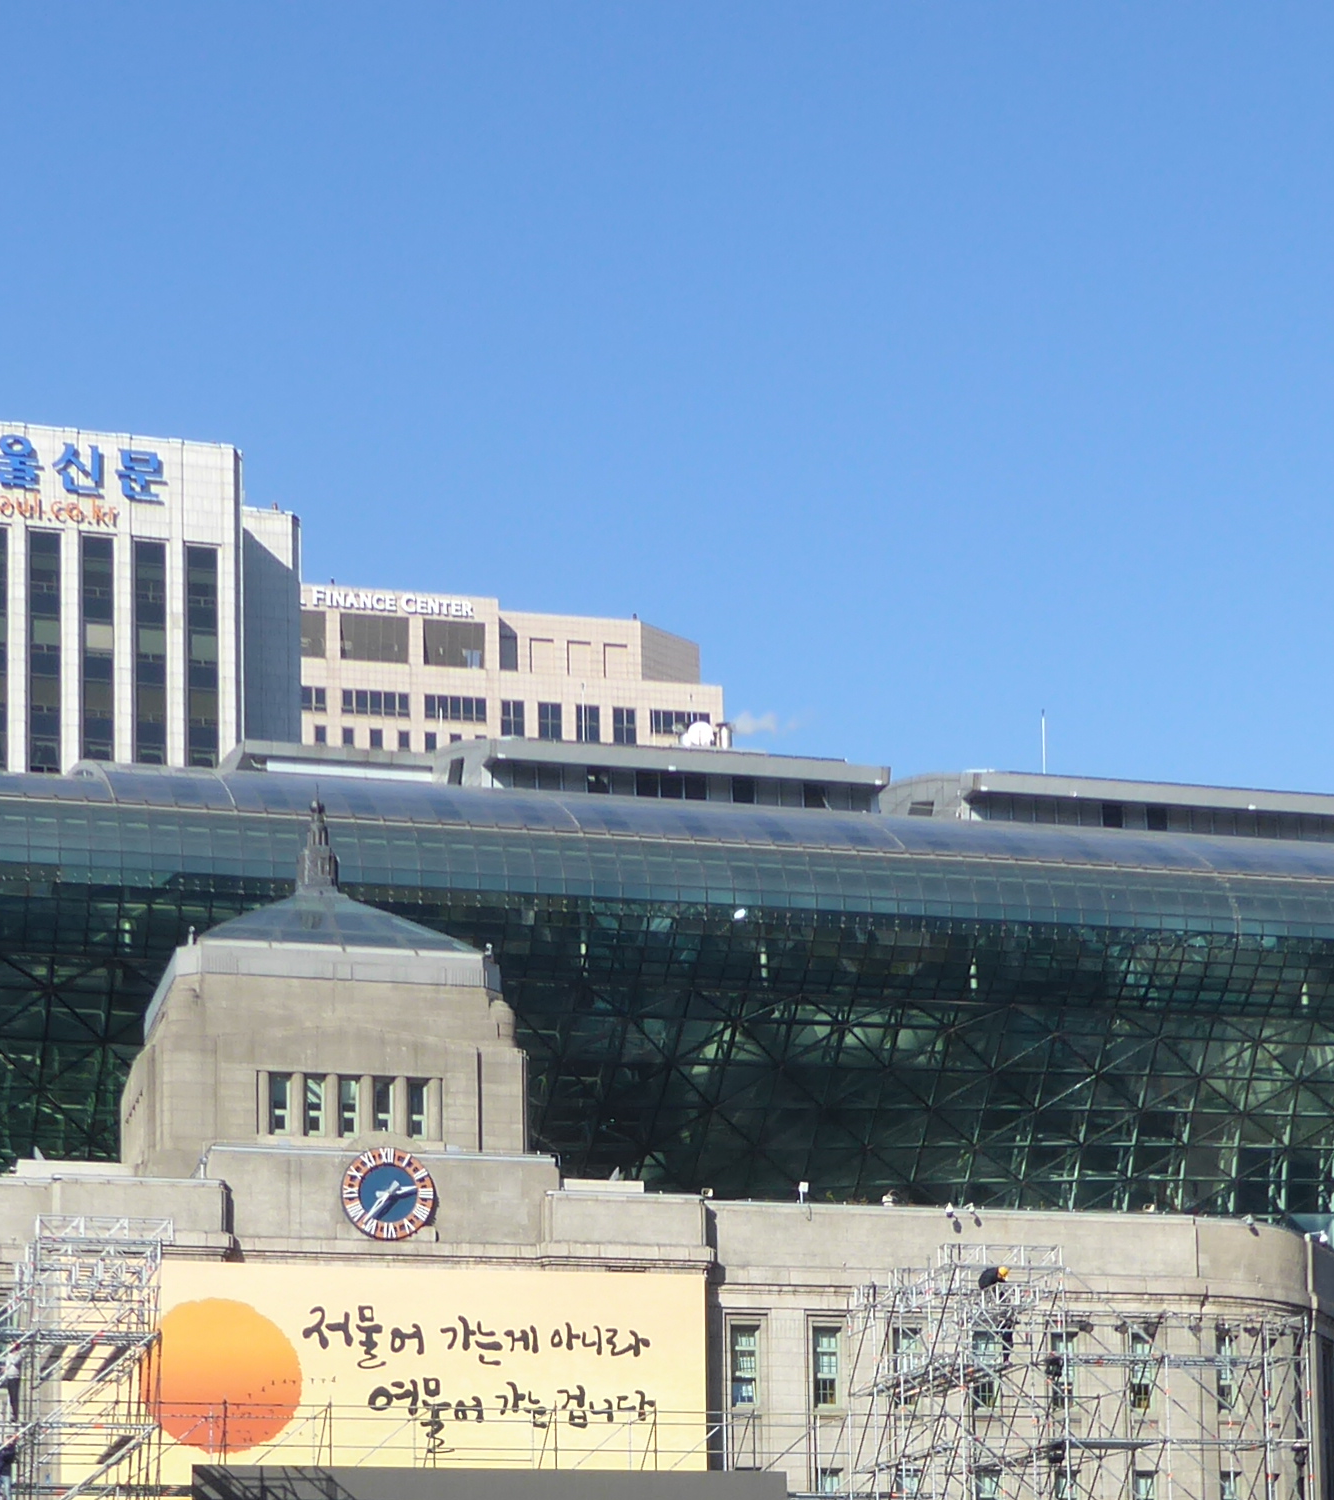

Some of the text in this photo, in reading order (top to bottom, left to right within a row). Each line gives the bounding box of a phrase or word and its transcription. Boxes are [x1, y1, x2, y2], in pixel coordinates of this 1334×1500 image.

[311, 586, 397, 613] FINANCE
[400, 593, 474, 618] CENTER
[302, 1304, 652, 1370] 저물어 가는게 아니라
[367, 1377, 658, 1454] 여물어 가는 겁니다
